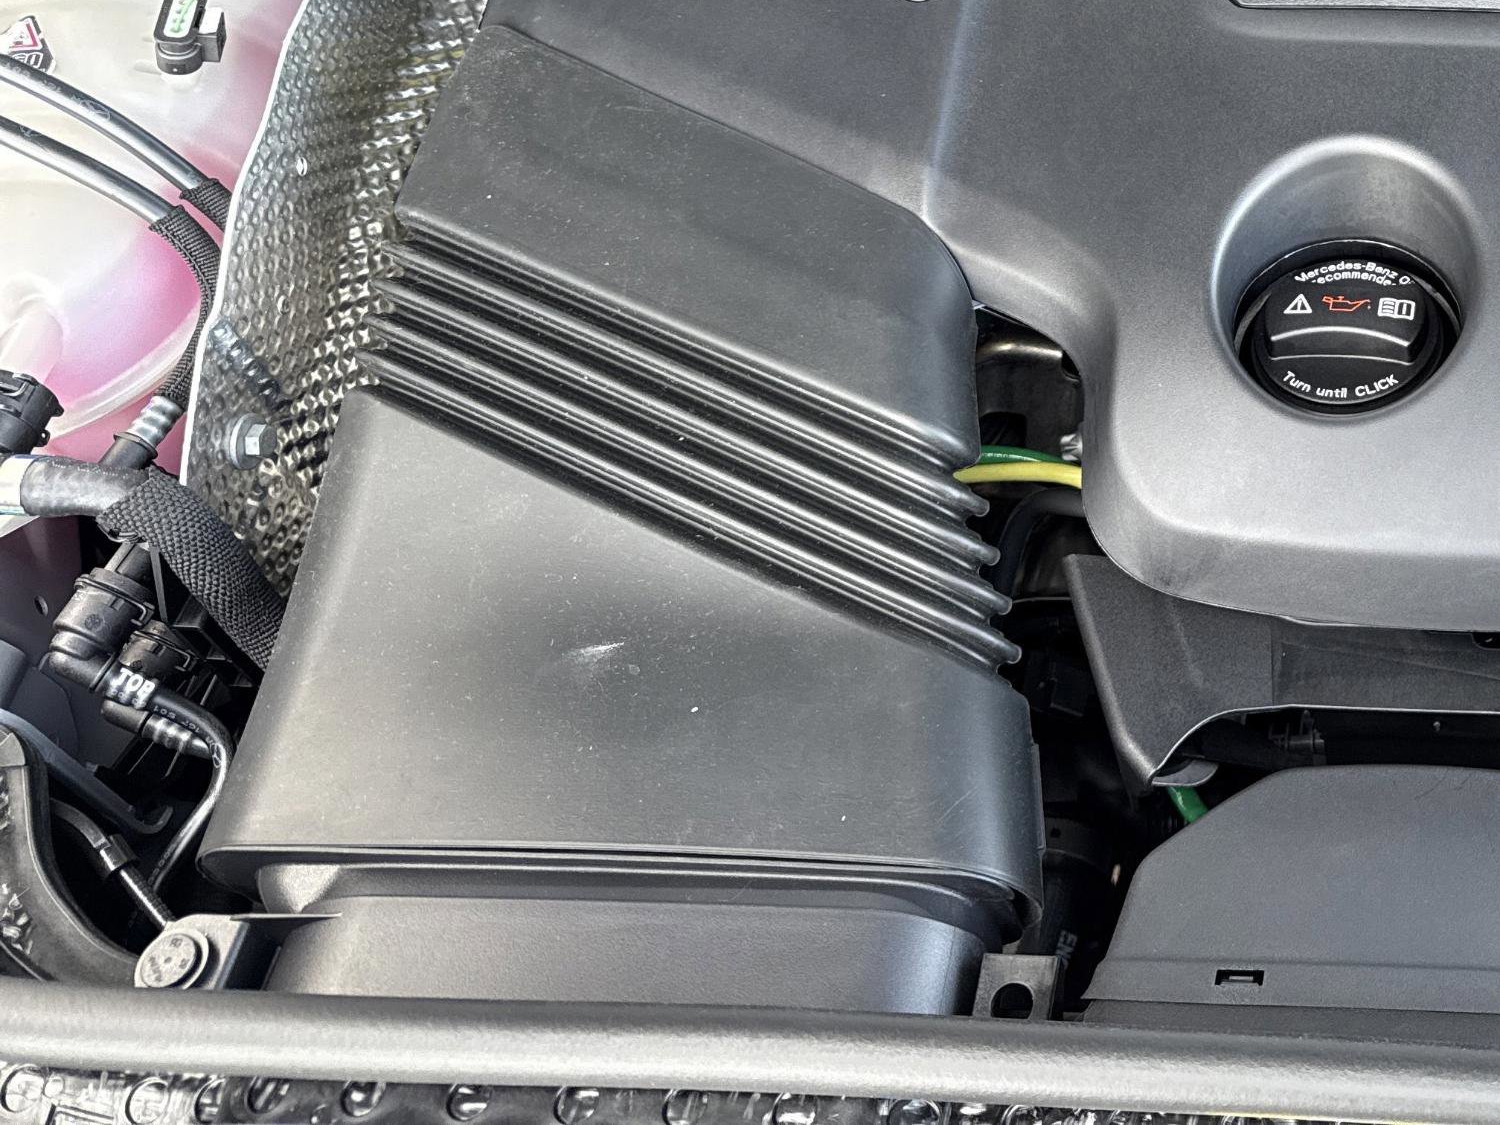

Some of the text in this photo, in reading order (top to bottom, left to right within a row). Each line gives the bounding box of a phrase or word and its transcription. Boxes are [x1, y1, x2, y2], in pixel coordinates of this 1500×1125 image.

[1294, 261, 1399, 282] Mercedes-Benz
[1283, 371, 1400, 399] Turn until CLICK
